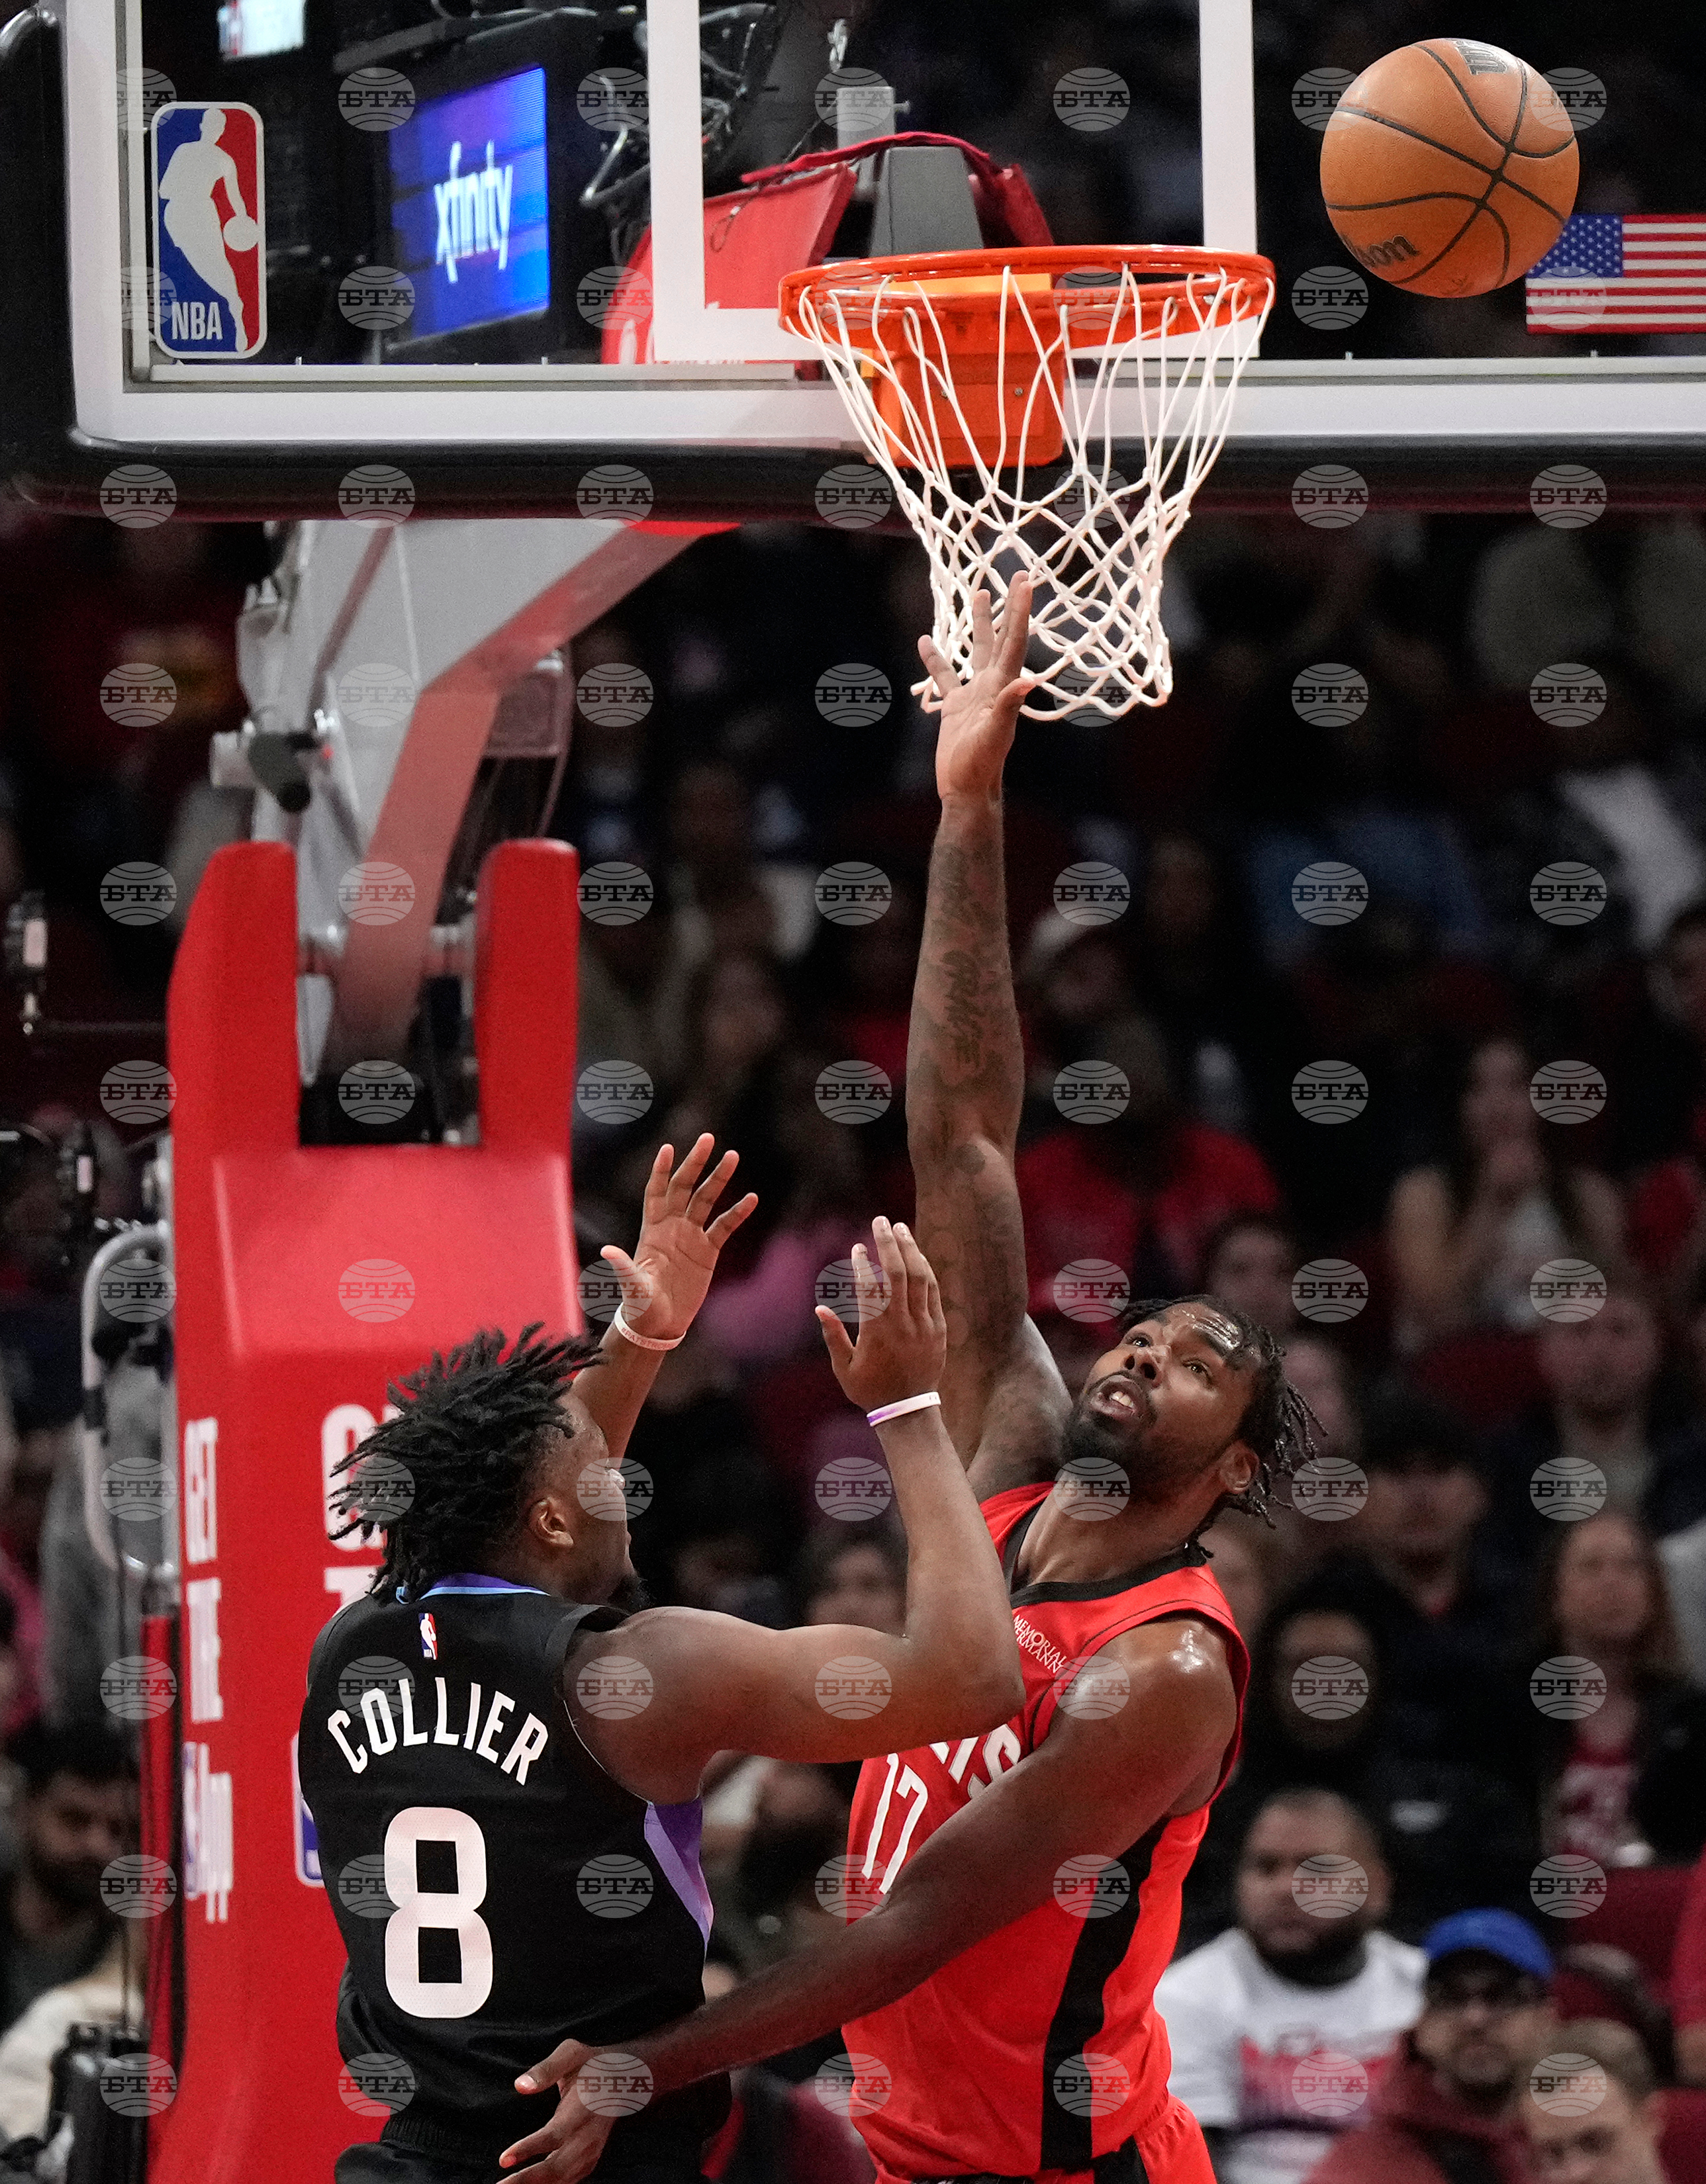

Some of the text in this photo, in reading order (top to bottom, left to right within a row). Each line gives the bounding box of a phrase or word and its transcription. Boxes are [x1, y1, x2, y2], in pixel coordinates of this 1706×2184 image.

[434, 140, 513, 284] xfinity
[172, 301, 223, 340] NBA
[1014, 1614, 1067, 1667] MEMORIAL
[328, 1676, 548, 1786] COLLIER
[861, 1752, 928, 1895] 17
[384, 1806, 493, 2019] 8
